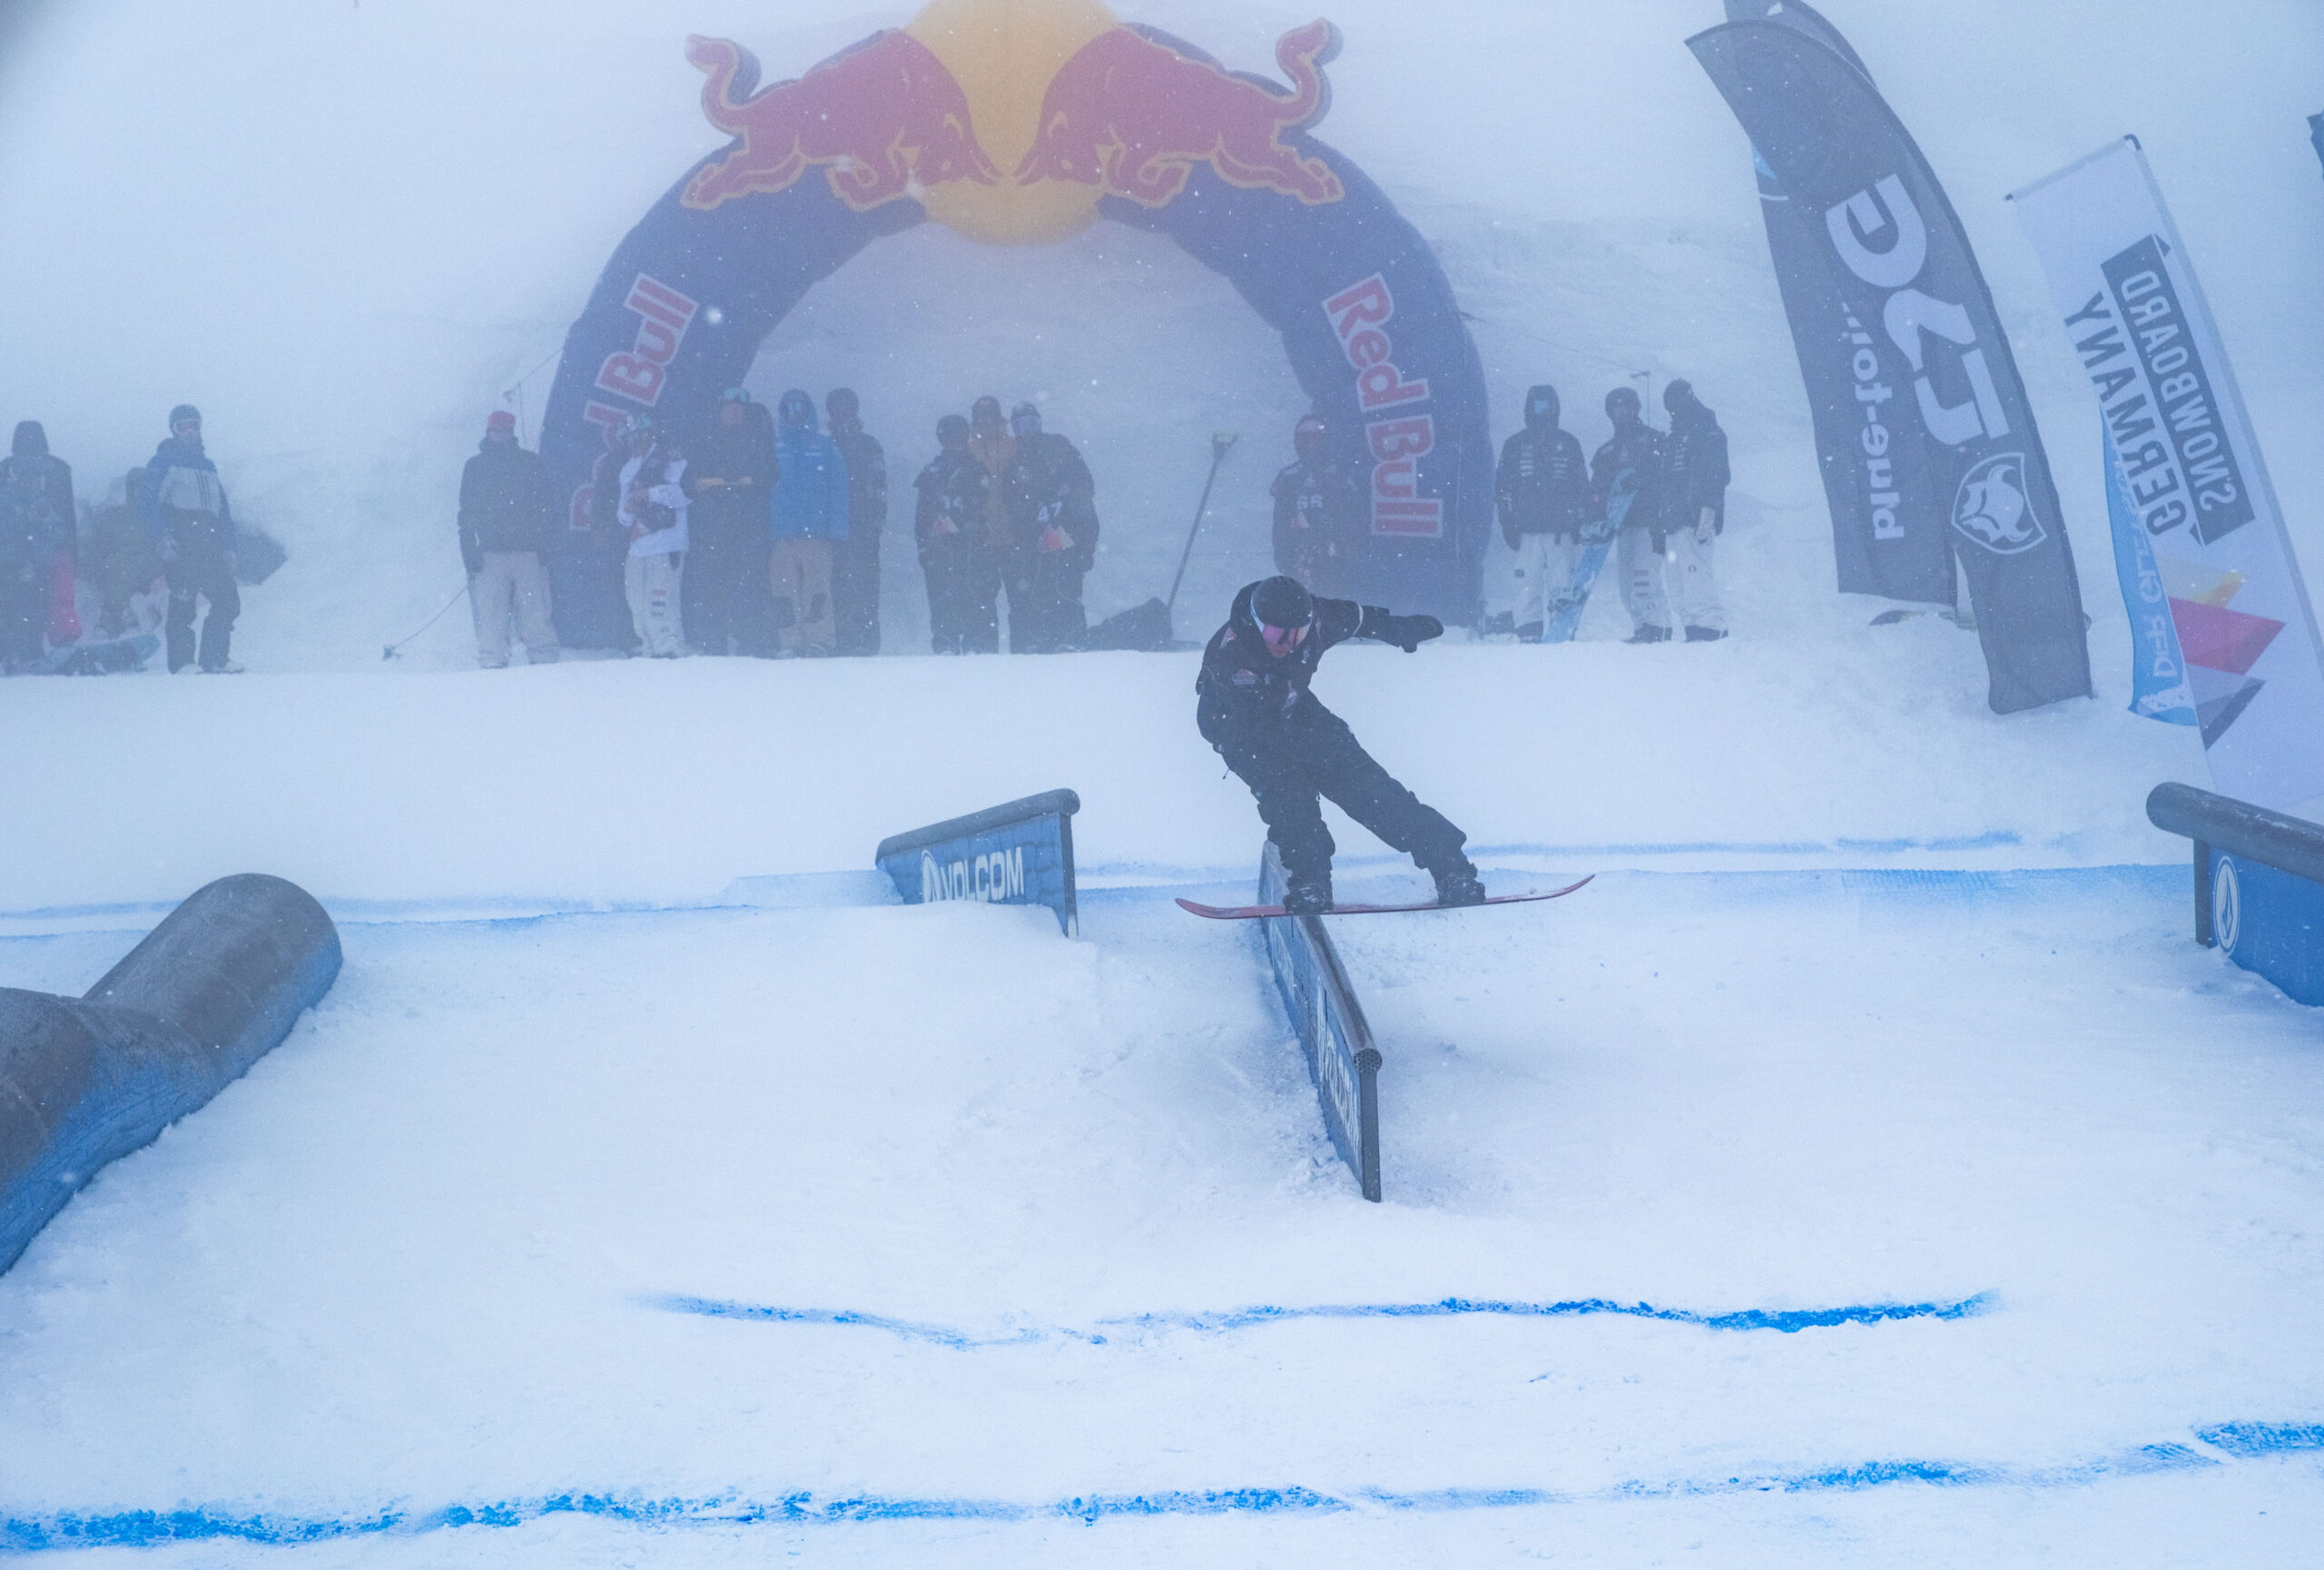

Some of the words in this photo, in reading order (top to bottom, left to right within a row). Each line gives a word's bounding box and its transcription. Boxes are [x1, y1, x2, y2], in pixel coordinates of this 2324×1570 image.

[595, 272, 700, 408] Bull
[1322, 272, 1430, 413] Red
[1364, 413, 1443, 538] Bull
[940, 846, 1024, 902] VOLCOM
